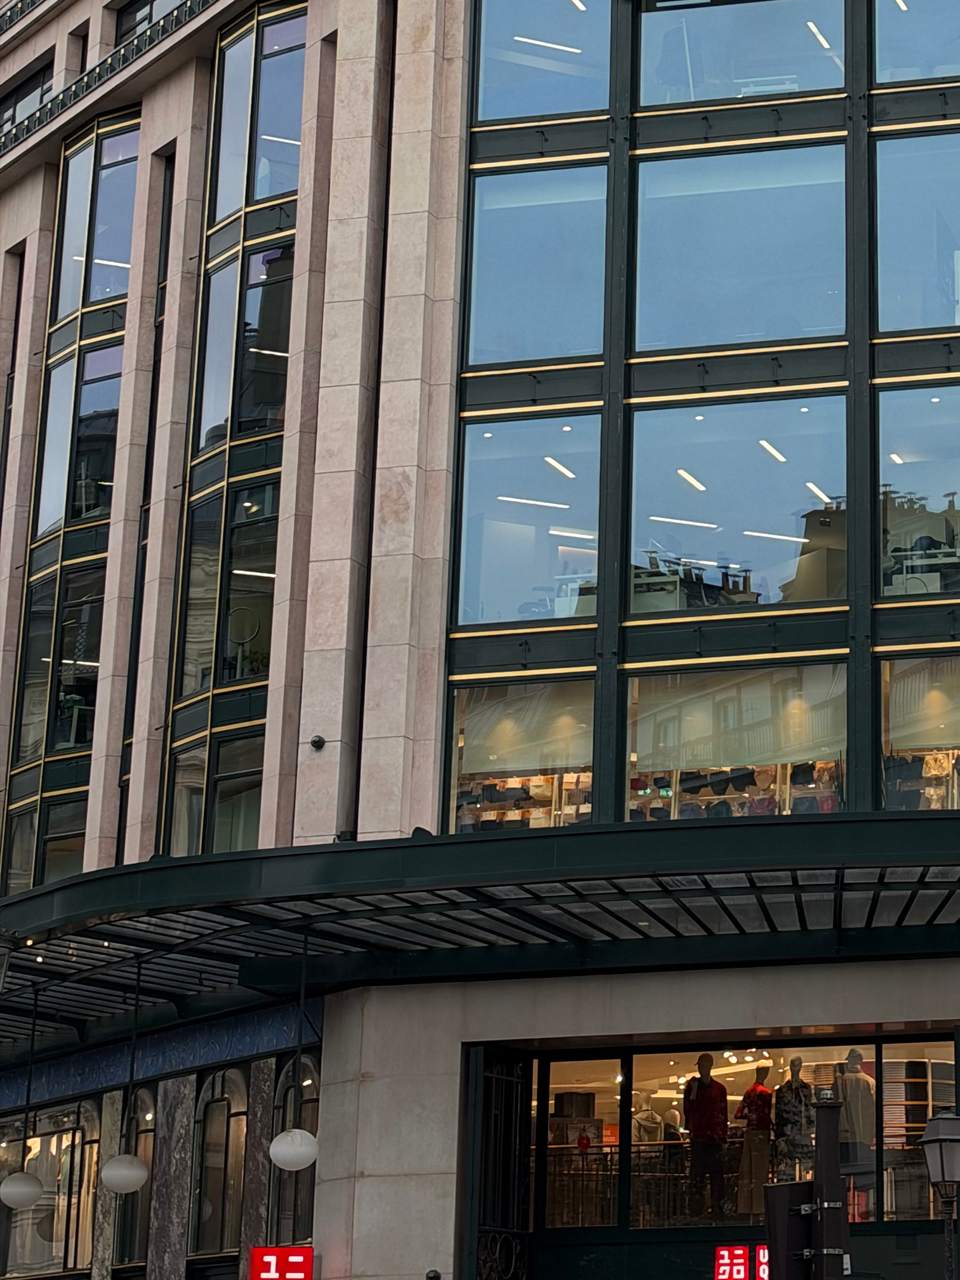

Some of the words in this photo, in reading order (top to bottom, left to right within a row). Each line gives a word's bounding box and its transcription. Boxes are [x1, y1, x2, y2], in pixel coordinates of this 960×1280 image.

[718, 1249, 745, 1263] ユニ
[260, 1255, 305, 1279] ユニ
[717, 1265, 745, 1279] クロ
